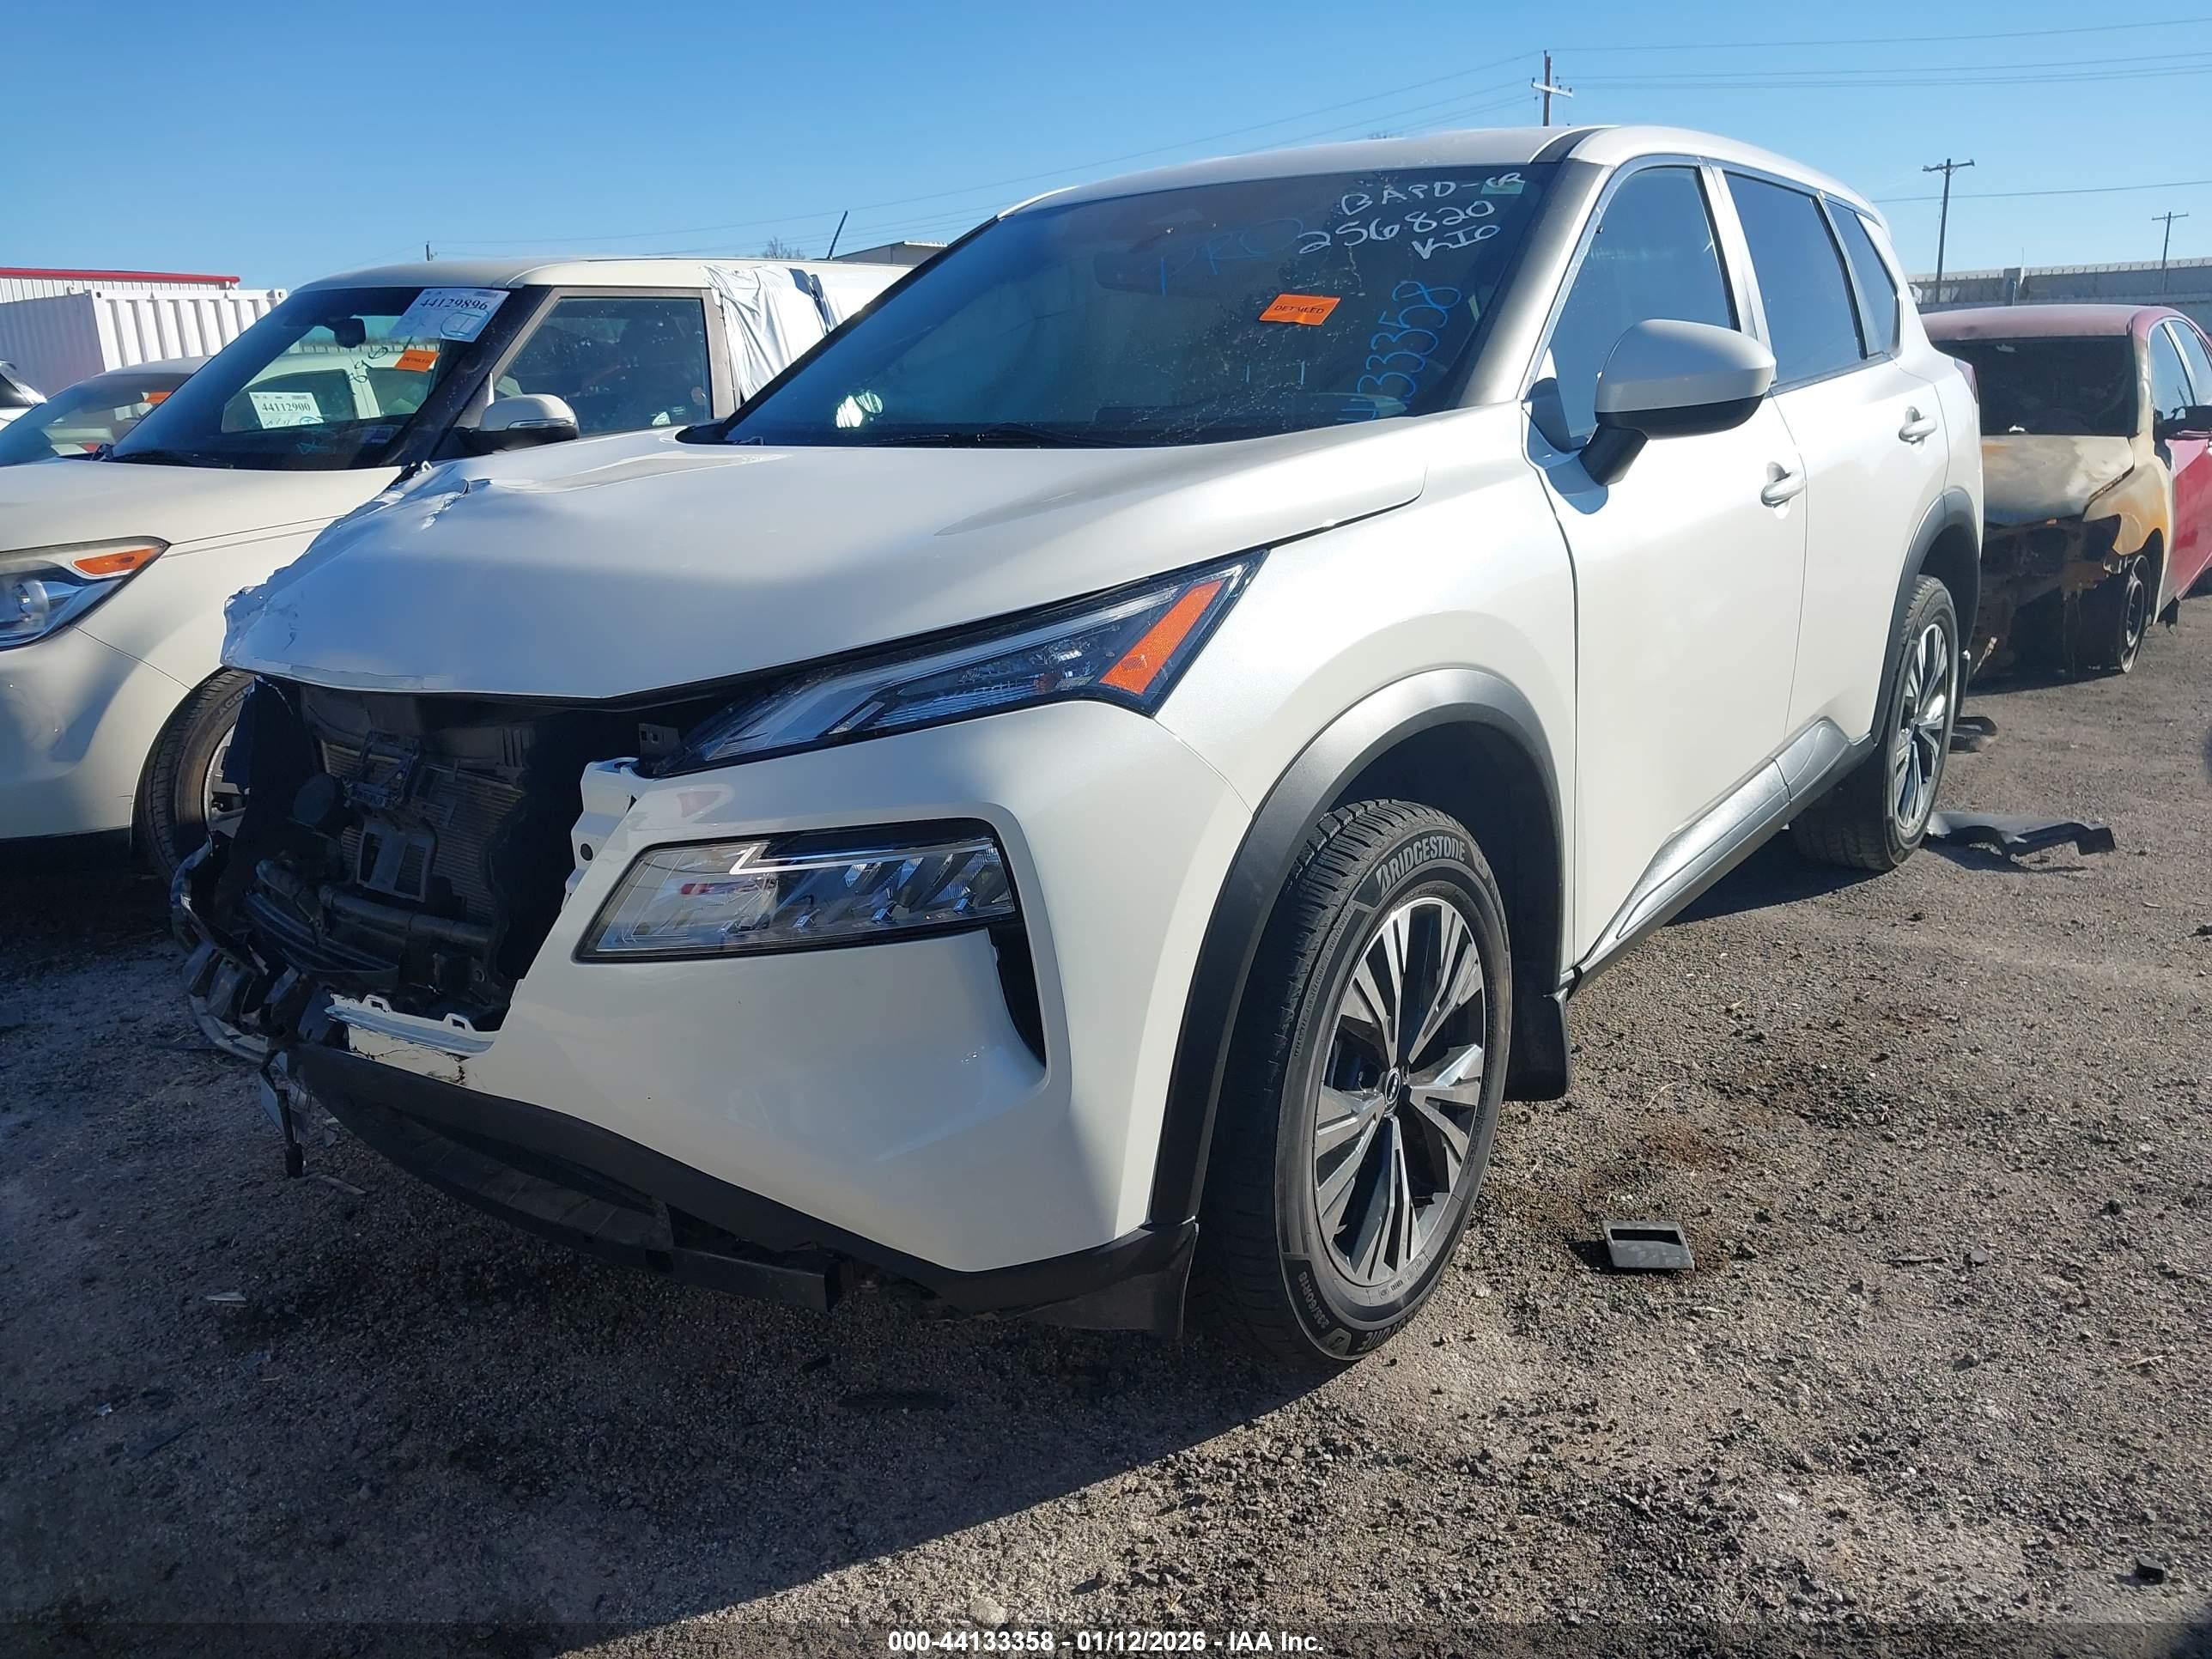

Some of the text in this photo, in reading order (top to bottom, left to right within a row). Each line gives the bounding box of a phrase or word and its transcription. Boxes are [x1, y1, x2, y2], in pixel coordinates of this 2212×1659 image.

[1297, 200, 1495, 255] 256820
[420, 297, 489, 311] 44129896
[1273, 305, 1325, 314] DETAILED
[262, 402, 312, 412] 44112900
[1376, 836, 1466, 898] BRIDGESTONE
